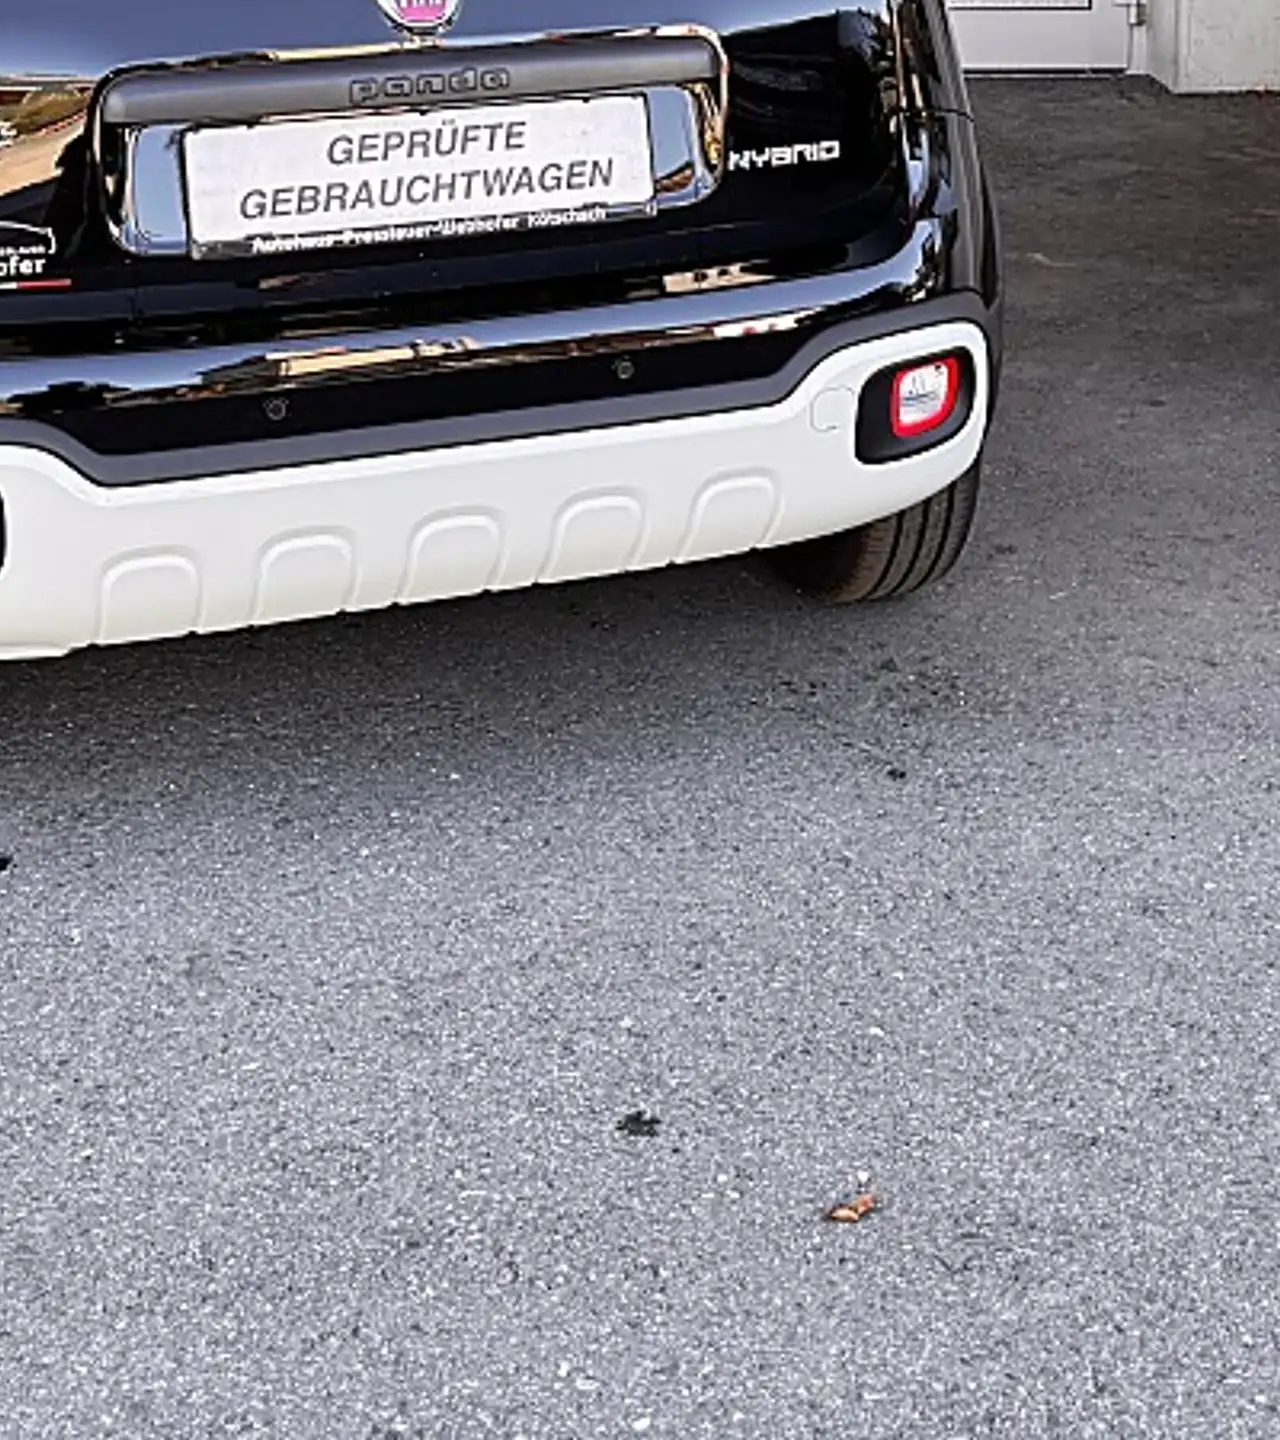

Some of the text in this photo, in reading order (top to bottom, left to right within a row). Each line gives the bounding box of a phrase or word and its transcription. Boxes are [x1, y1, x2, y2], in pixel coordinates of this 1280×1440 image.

[348, 65, 512, 107] panda
[326, 118, 528, 166] GEPRÜFTE
[727, 139, 841, 172] HYBRID
[238, 157, 615, 221] GEBRAUCHTWAGEN
